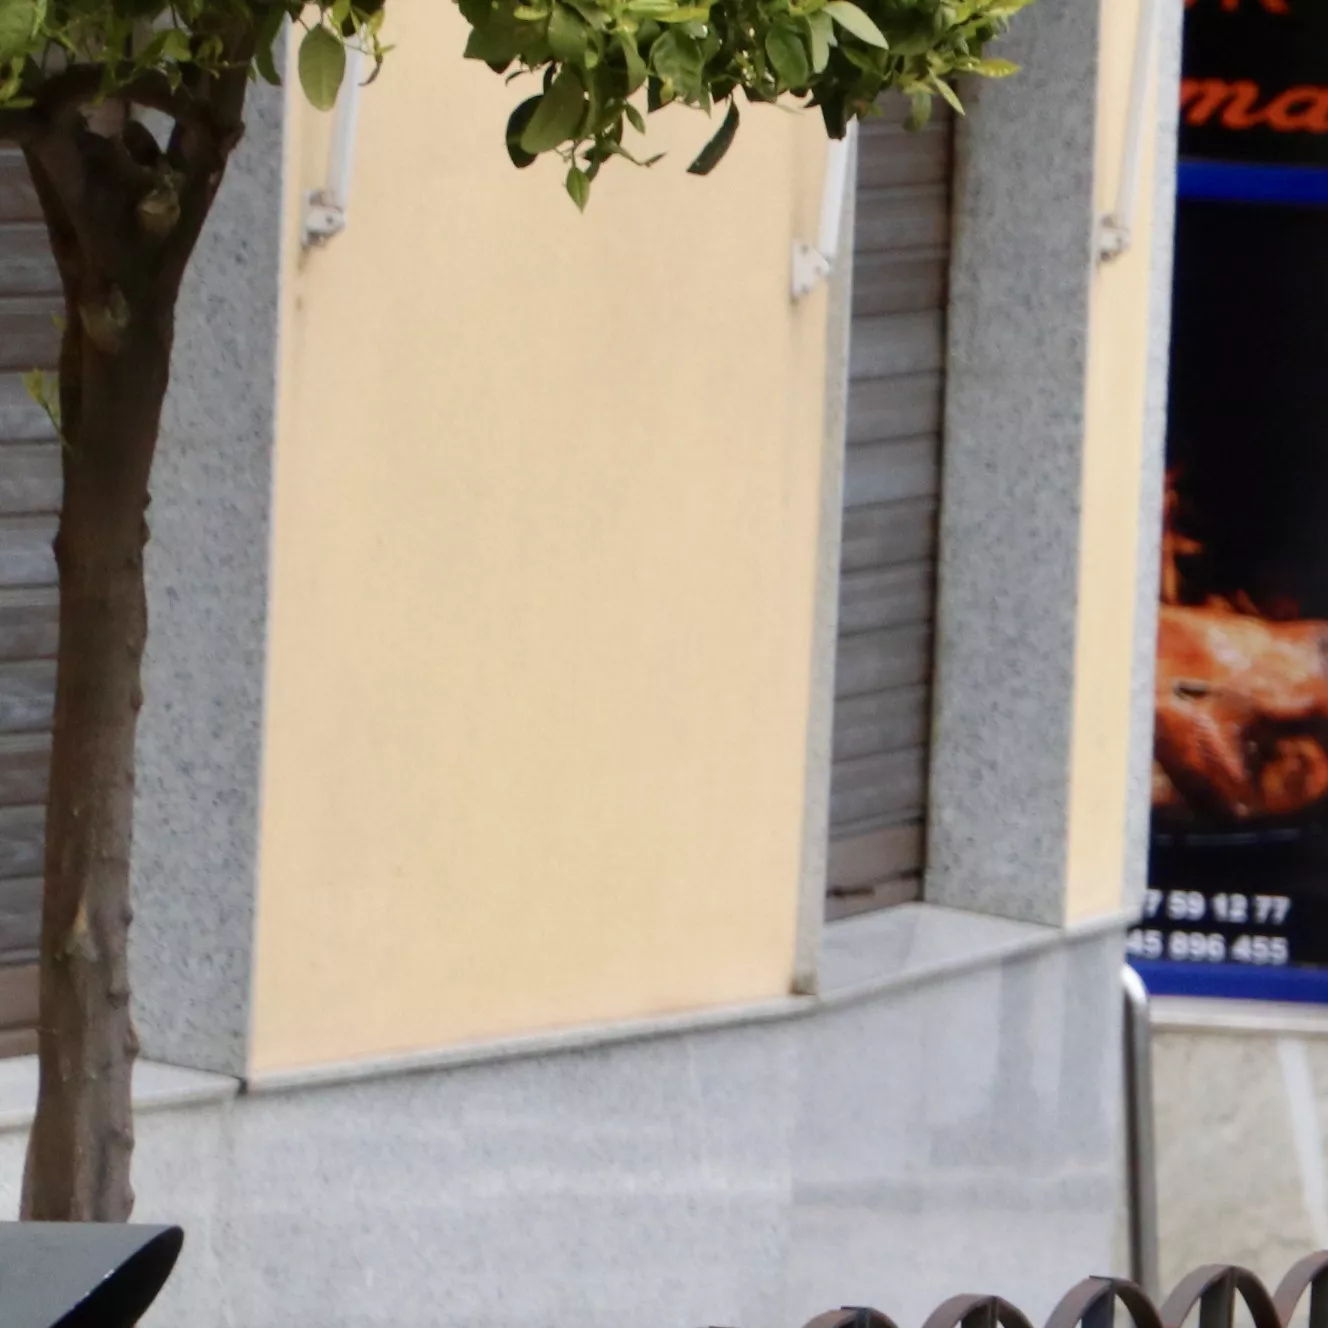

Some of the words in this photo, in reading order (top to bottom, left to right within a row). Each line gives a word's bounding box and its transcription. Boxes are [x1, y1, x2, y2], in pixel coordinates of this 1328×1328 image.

[1168, 889, 1206, 921] 59
[1212, 892, 1248, 923] 12
[1254, 895, 1290, 925] 77
[1168, 930, 1226, 963] 896
[1231, 934, 1288, 965] 455
